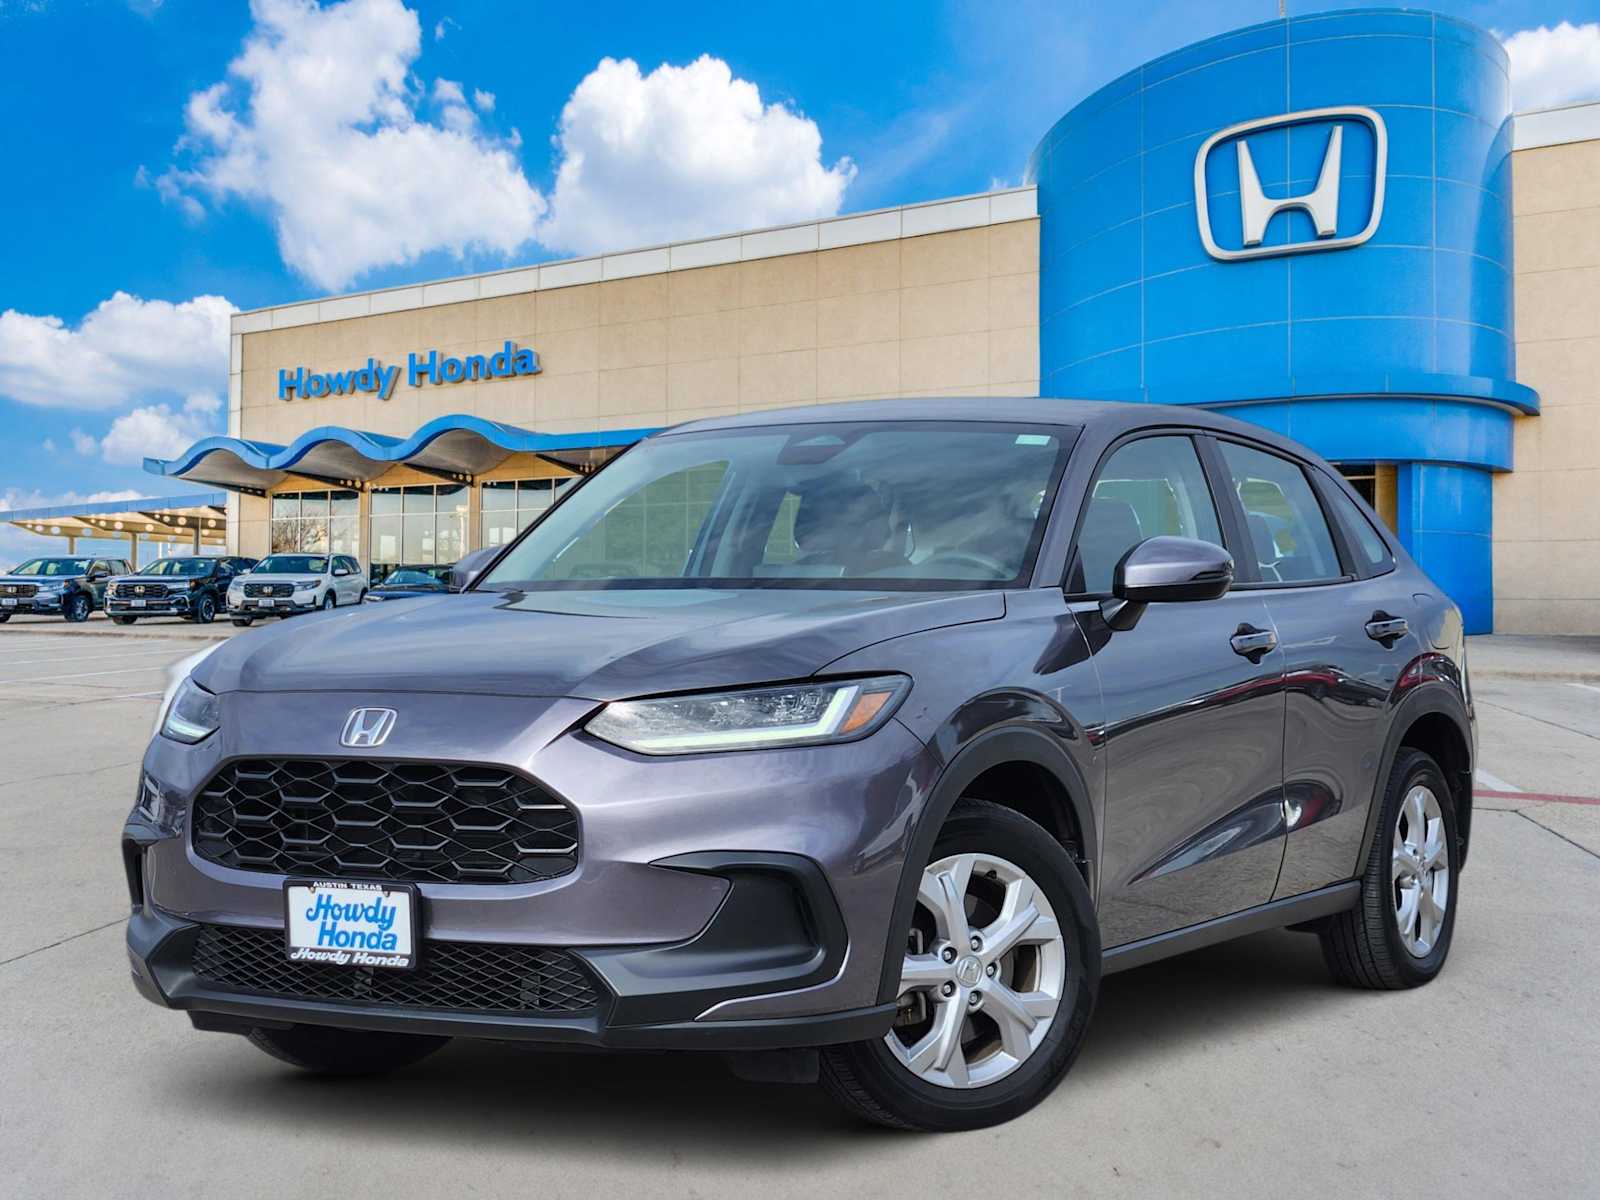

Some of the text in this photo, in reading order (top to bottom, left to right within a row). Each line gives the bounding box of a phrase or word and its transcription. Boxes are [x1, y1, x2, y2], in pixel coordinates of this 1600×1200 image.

[278, 340, 542, 401] Howdy Honda
[313, 881, 382, 891] AUSTIN TEXAS
[306, 893, 397, 931] Howdy
[317, 920, 397, 950] Honda
[290, 948, 409, 967] Howdy Honda
